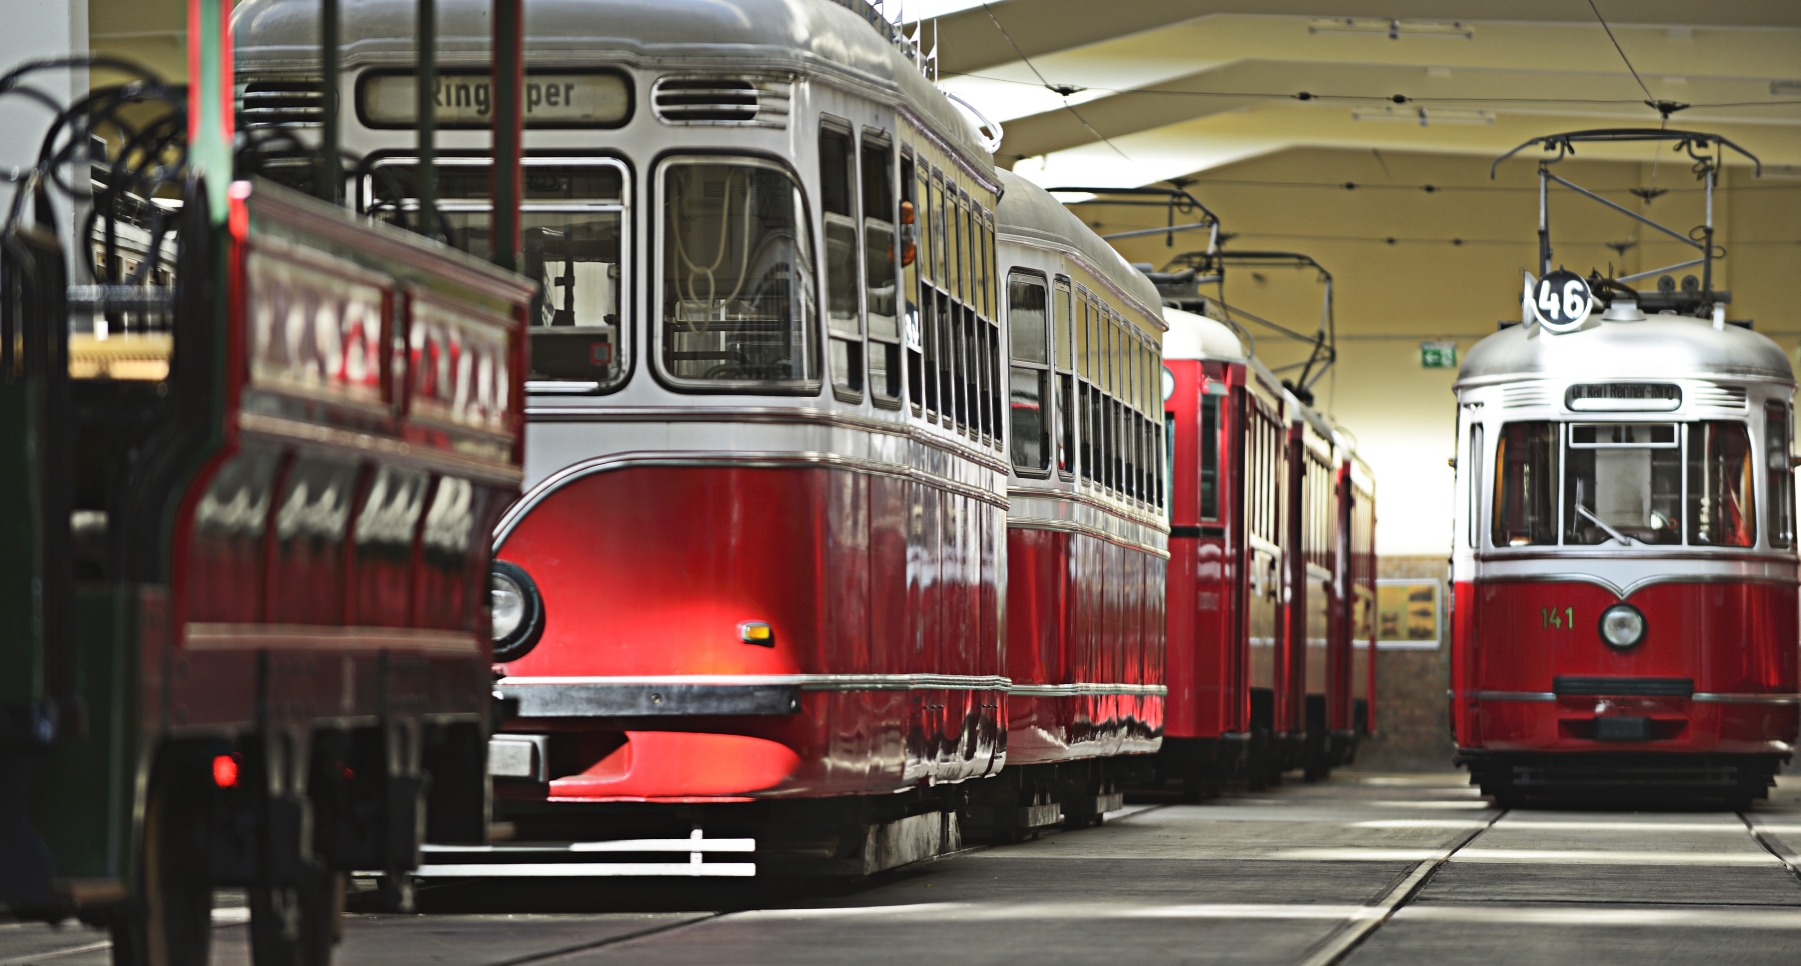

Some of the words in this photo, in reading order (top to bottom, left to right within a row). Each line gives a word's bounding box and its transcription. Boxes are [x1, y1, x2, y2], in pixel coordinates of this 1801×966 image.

[1538, 279, 1585, 320] 46
[1572, 384, 1586, 399] Dr.
[1587, 384, 1606, 398] Karl
[1609, 384, 1674, 400] Renner-Ring
[1540, 605, 1574, 630] 141
